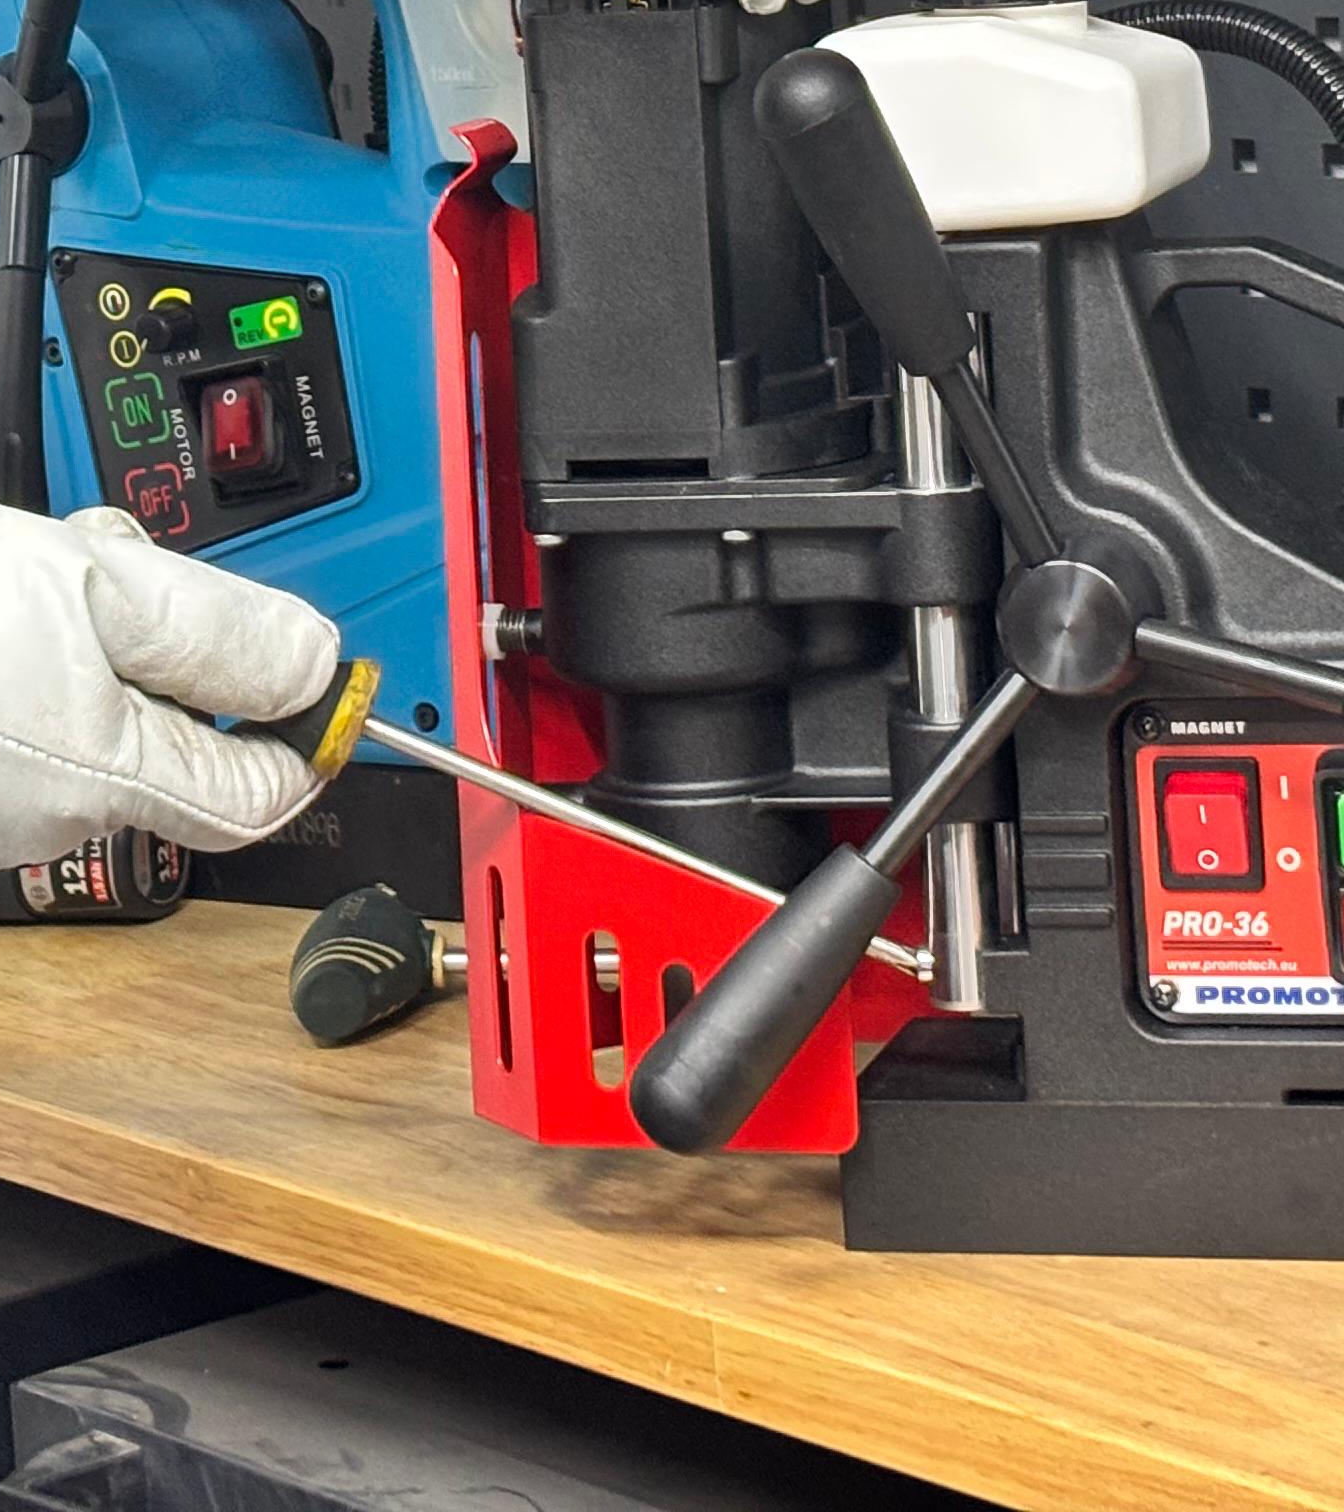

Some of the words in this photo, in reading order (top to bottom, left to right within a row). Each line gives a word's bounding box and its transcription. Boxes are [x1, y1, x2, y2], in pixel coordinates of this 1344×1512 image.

[122, 393, 154, 429] ON
[295, 374, 325, 460] MAGNET
[169, 407, 197, 482] MOTOR
[139, 487, 174, 518] OFF
[1170, 720, 1246, 735] MAGNET
[1162, 910, 1269, 937] PRO-36
[1166, 959, 1297, 973] www.promotech.eu
